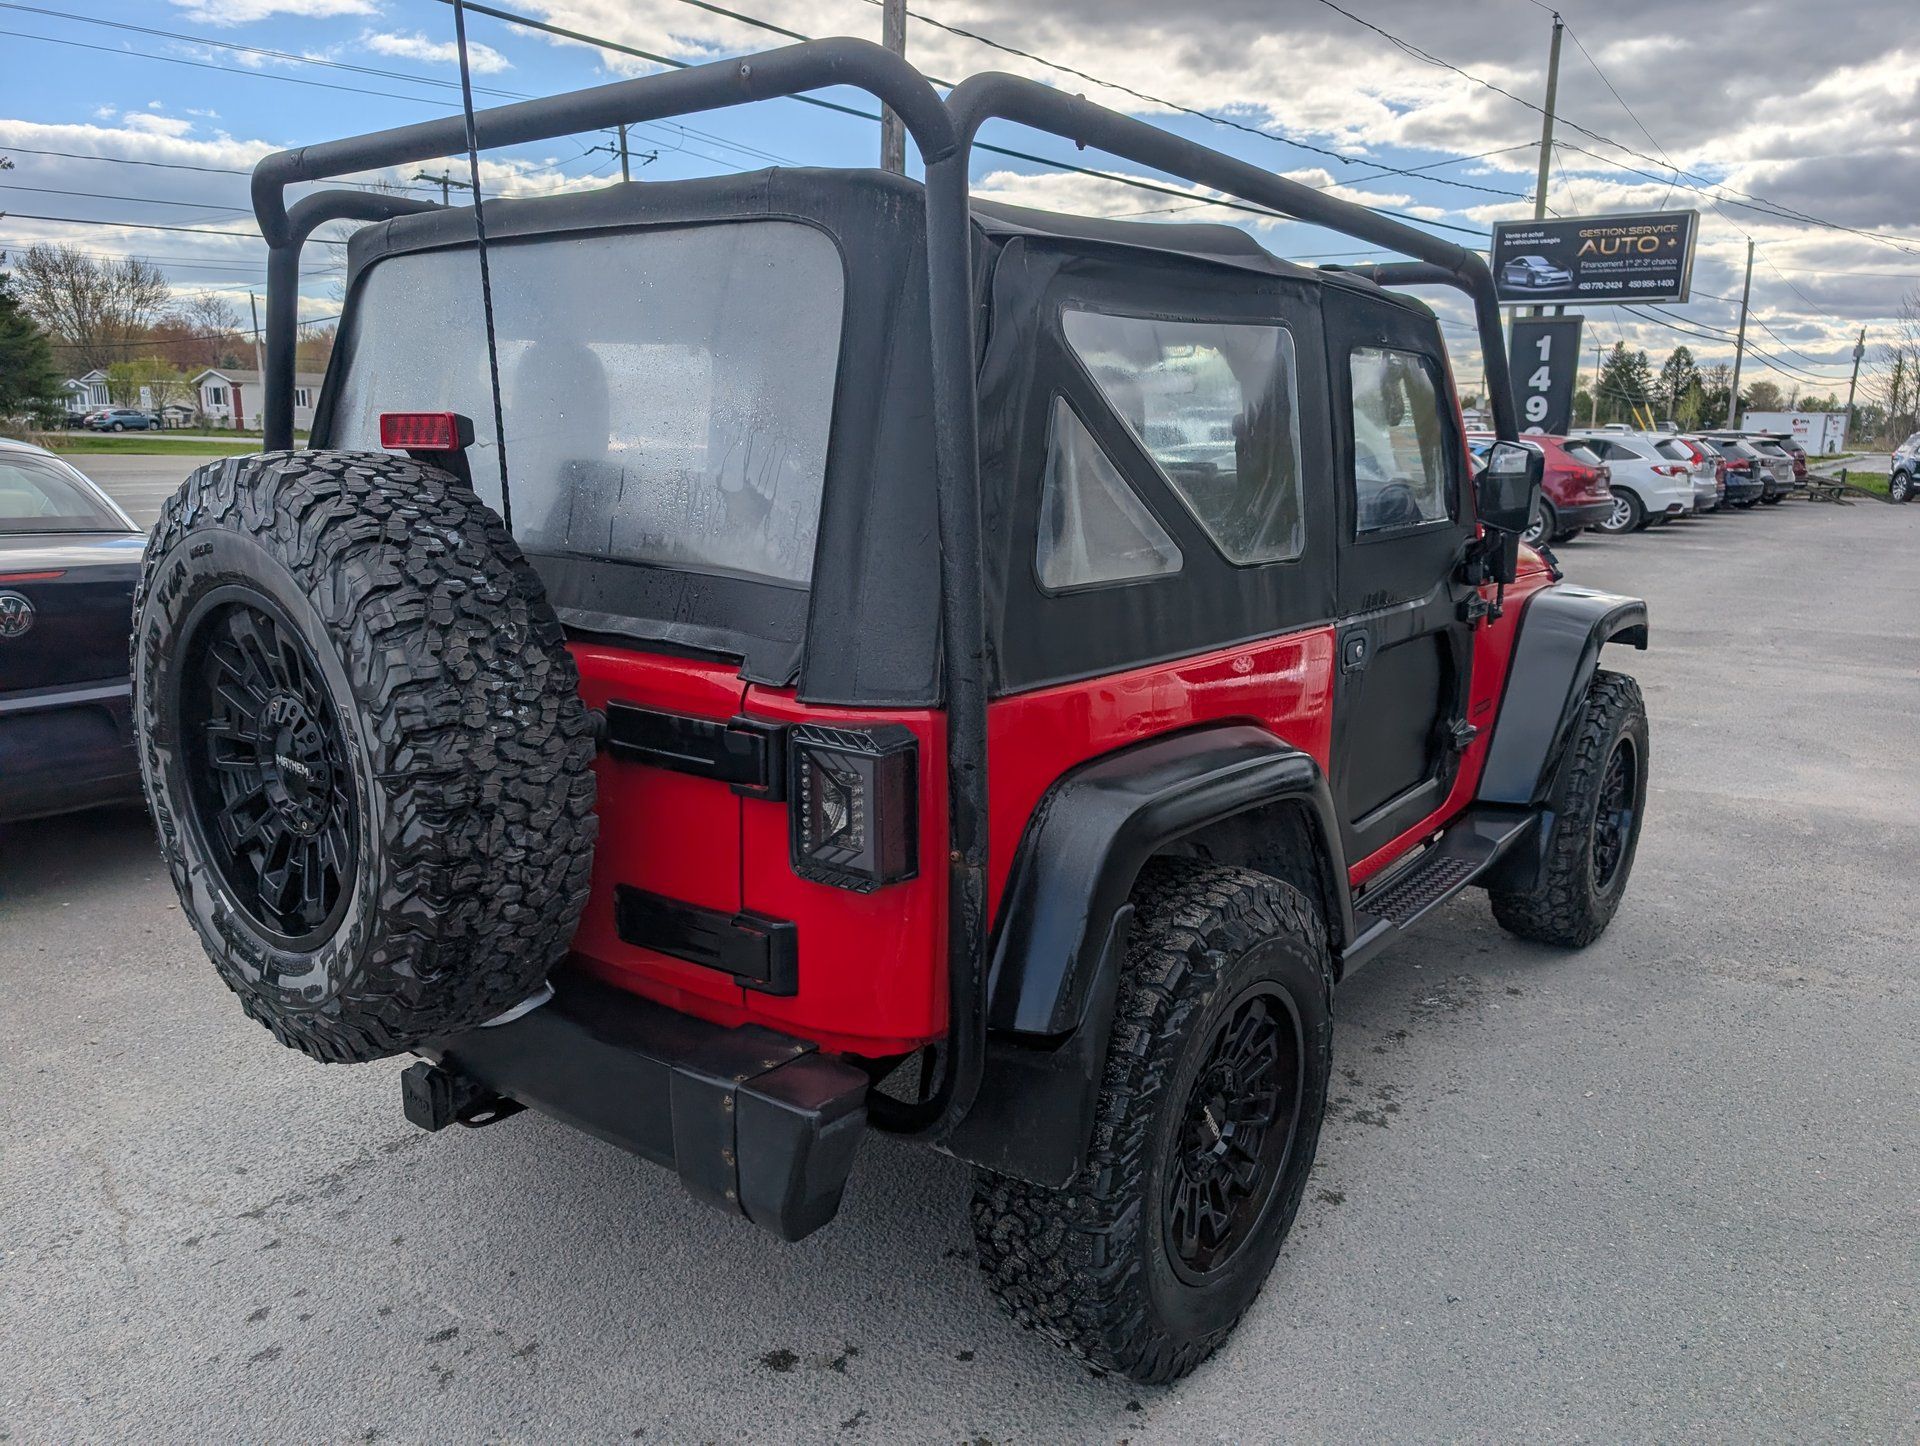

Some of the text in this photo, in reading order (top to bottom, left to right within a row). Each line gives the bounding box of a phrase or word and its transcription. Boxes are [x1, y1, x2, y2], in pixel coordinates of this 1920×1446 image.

[1579, 224, 1678, 238] GESTION SERVICE
[1576, 236, 1660, 257] AUTO
[1580, 261, 1624, 269] Financement
[1651, 258, 1678, 266] chance
[275, 753, 309, 777] MAYHEM
